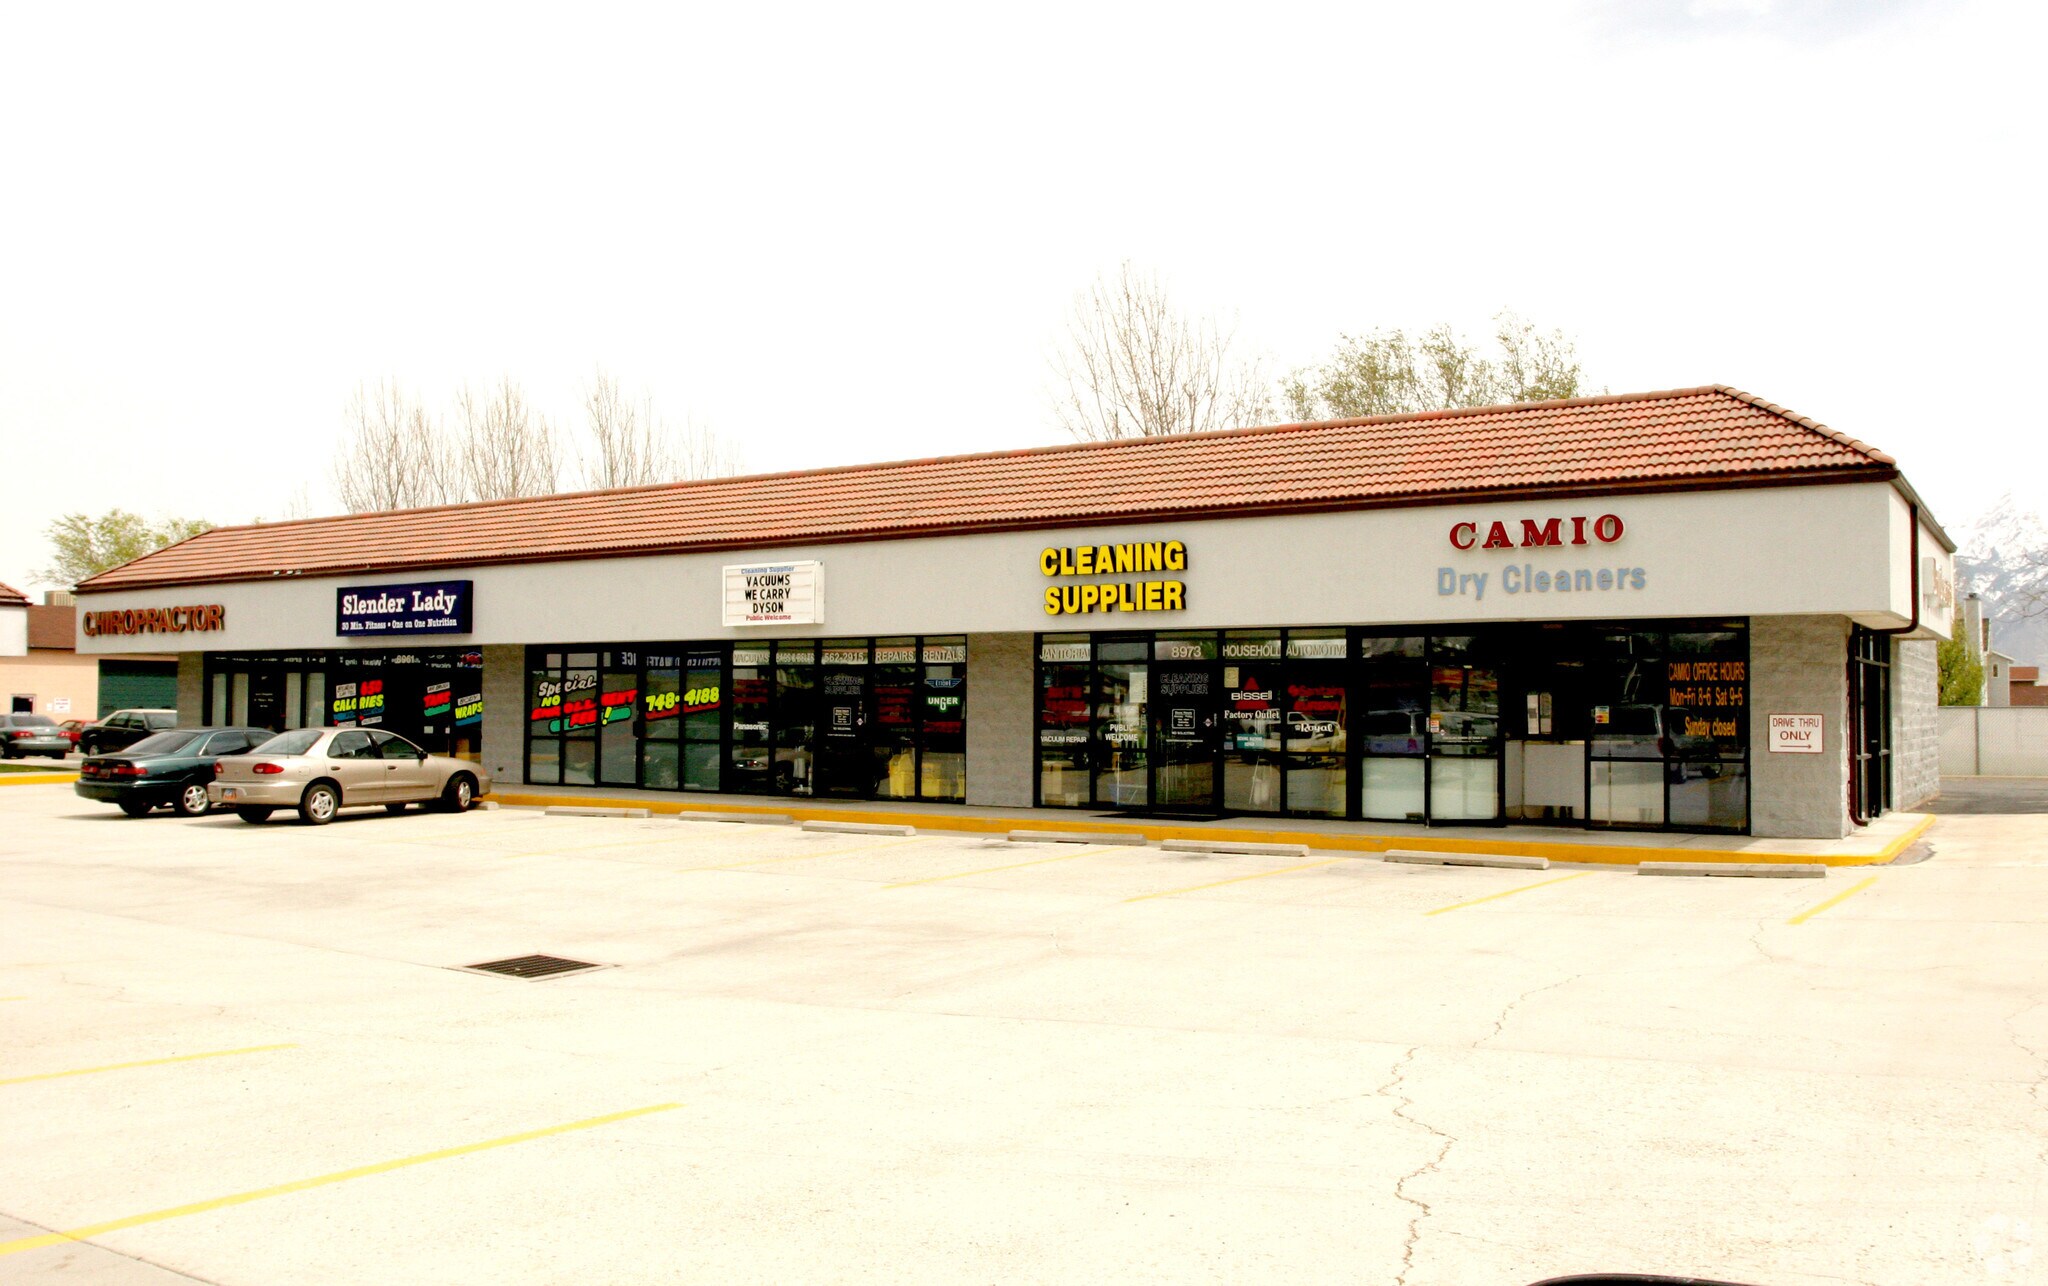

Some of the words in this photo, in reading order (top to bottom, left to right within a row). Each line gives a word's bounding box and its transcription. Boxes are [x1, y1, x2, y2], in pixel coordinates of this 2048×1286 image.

[1449, 514, 1626, 550] CAMIO
[1040, 540, 1187, 577] CLEANING
[741, 567, 768, 575] Cleaning
[769, 565, 795, 573] Supplier
[746, 574, 791, 587] VACUUMS
[1437, 567, 1489, 601] Dry
[1502, 563, 1647, 595] Cleaners
[745, 590, 758, 600] WE
[760, 588, 791, 600] CARRY
[1044, 581, 1186, 615] SUPPLIER
[342, 593, 405, 615] Slender
[412, 589, 457, 615] Lady
[753, 602, 784, 613] DYSON
[83, 604, 225, 637] CHIROPRACTOR
[365, 621, 387, 630] Fitness
[392, 619, 404, 629] One
[405, 620, 413, 628] on
[414, 619, 426, 628] One
[427, 617, 457, 627] Nutrition
[824, 652, 864, 662] 562-2915
[875, 650, 915, 661] REPAIRS
[922, 649, 965, 661] RENTALS
[1170, 645, 1202, 659] 8973
[1669, 661, 1691, 681] CAMIO
[1692, 661, 1719, 681] OFFICE
[1720, 661, 1745, 681] HOURS
[1160, 672, 1209, 684] CLEANING
[538, 674, 598, 697] Special
[1160, 683, 1209, 696] SUPPLIER
[541, 695, 561, 707] NO
[1669, 687, 1696, 706] Mon-Fri
[1698, 687, 1712, 706] 8-6
[1715, 686, 1728, 706] Sat
[1729, 686, 1744, 706] 9-5
[927, 696, 959, 711] UNGER
[455, 701, 483, 719] WRAPS
[1224, 709, 1254, 720] Factory
[1255, 709, 1281, 720] Outlet
[733, 721, 767, 731] Panasonic
[1109, 723, 1135, 733] PUBLIC
[1300, 722, 1334, 733] Royal
[1684, 716, 1711, 740] Sunday
[1712, 716, 1737, 737] closed
[1772, 717, 1795, 729] DRIVE
[1798, 717, 1820, 729] THRU
[1040, 734, 1066, 744] VACUUM
[1066, 735, 1088, 744] REPAIR
[1104, 732, 1138, 743] WELCOME
[1780, 730, 1811, 741] ONLY
